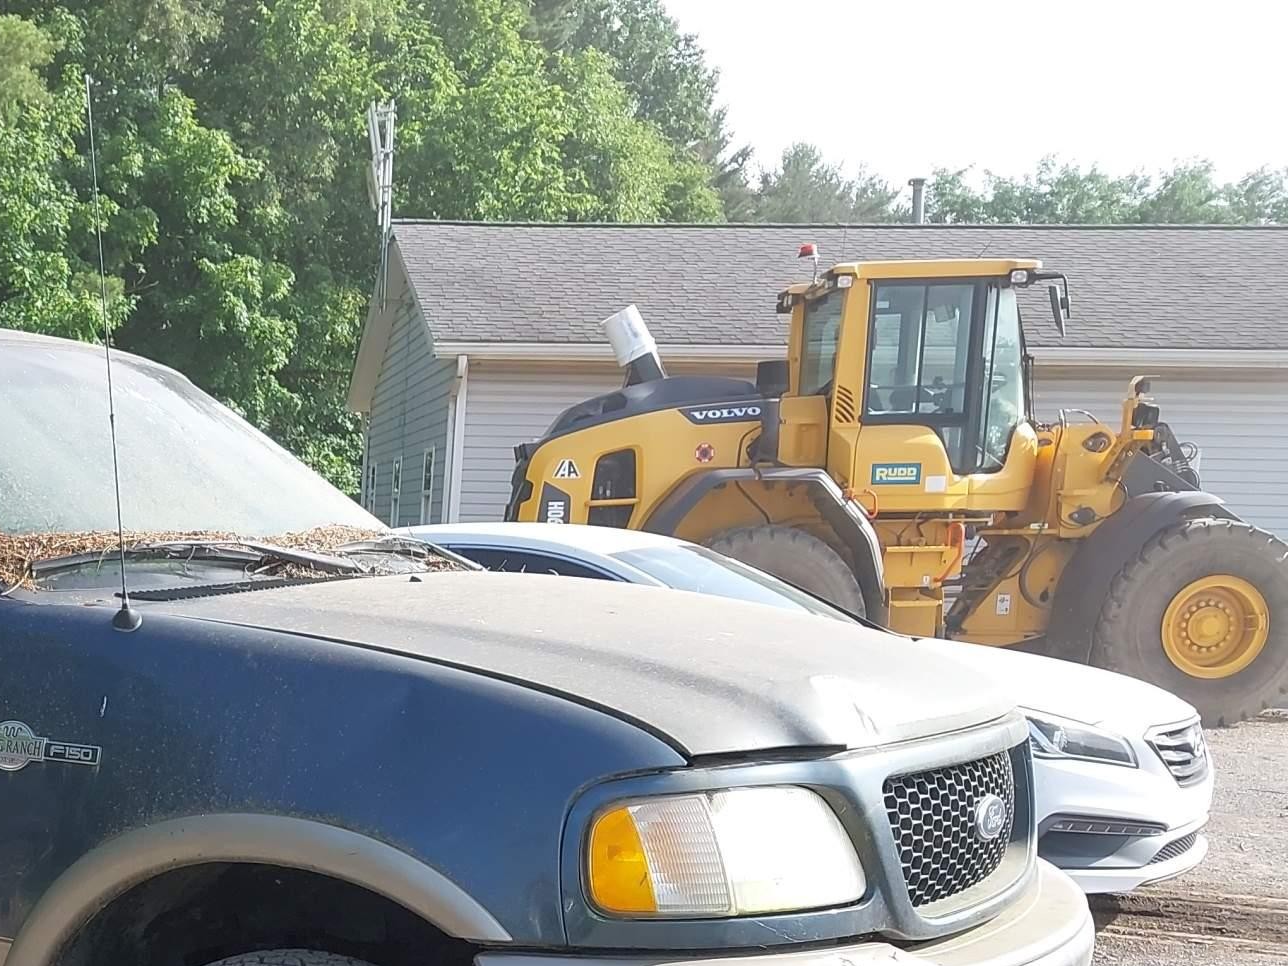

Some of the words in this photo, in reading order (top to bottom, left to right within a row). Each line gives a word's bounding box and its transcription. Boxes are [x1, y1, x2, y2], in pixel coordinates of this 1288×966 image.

[691, 407, 761, 419] VOLVO
[875, 467, 917, 481] RUDD
[6, 740, 42, 757] RANCH
[50, 744, 92, 761] F150
